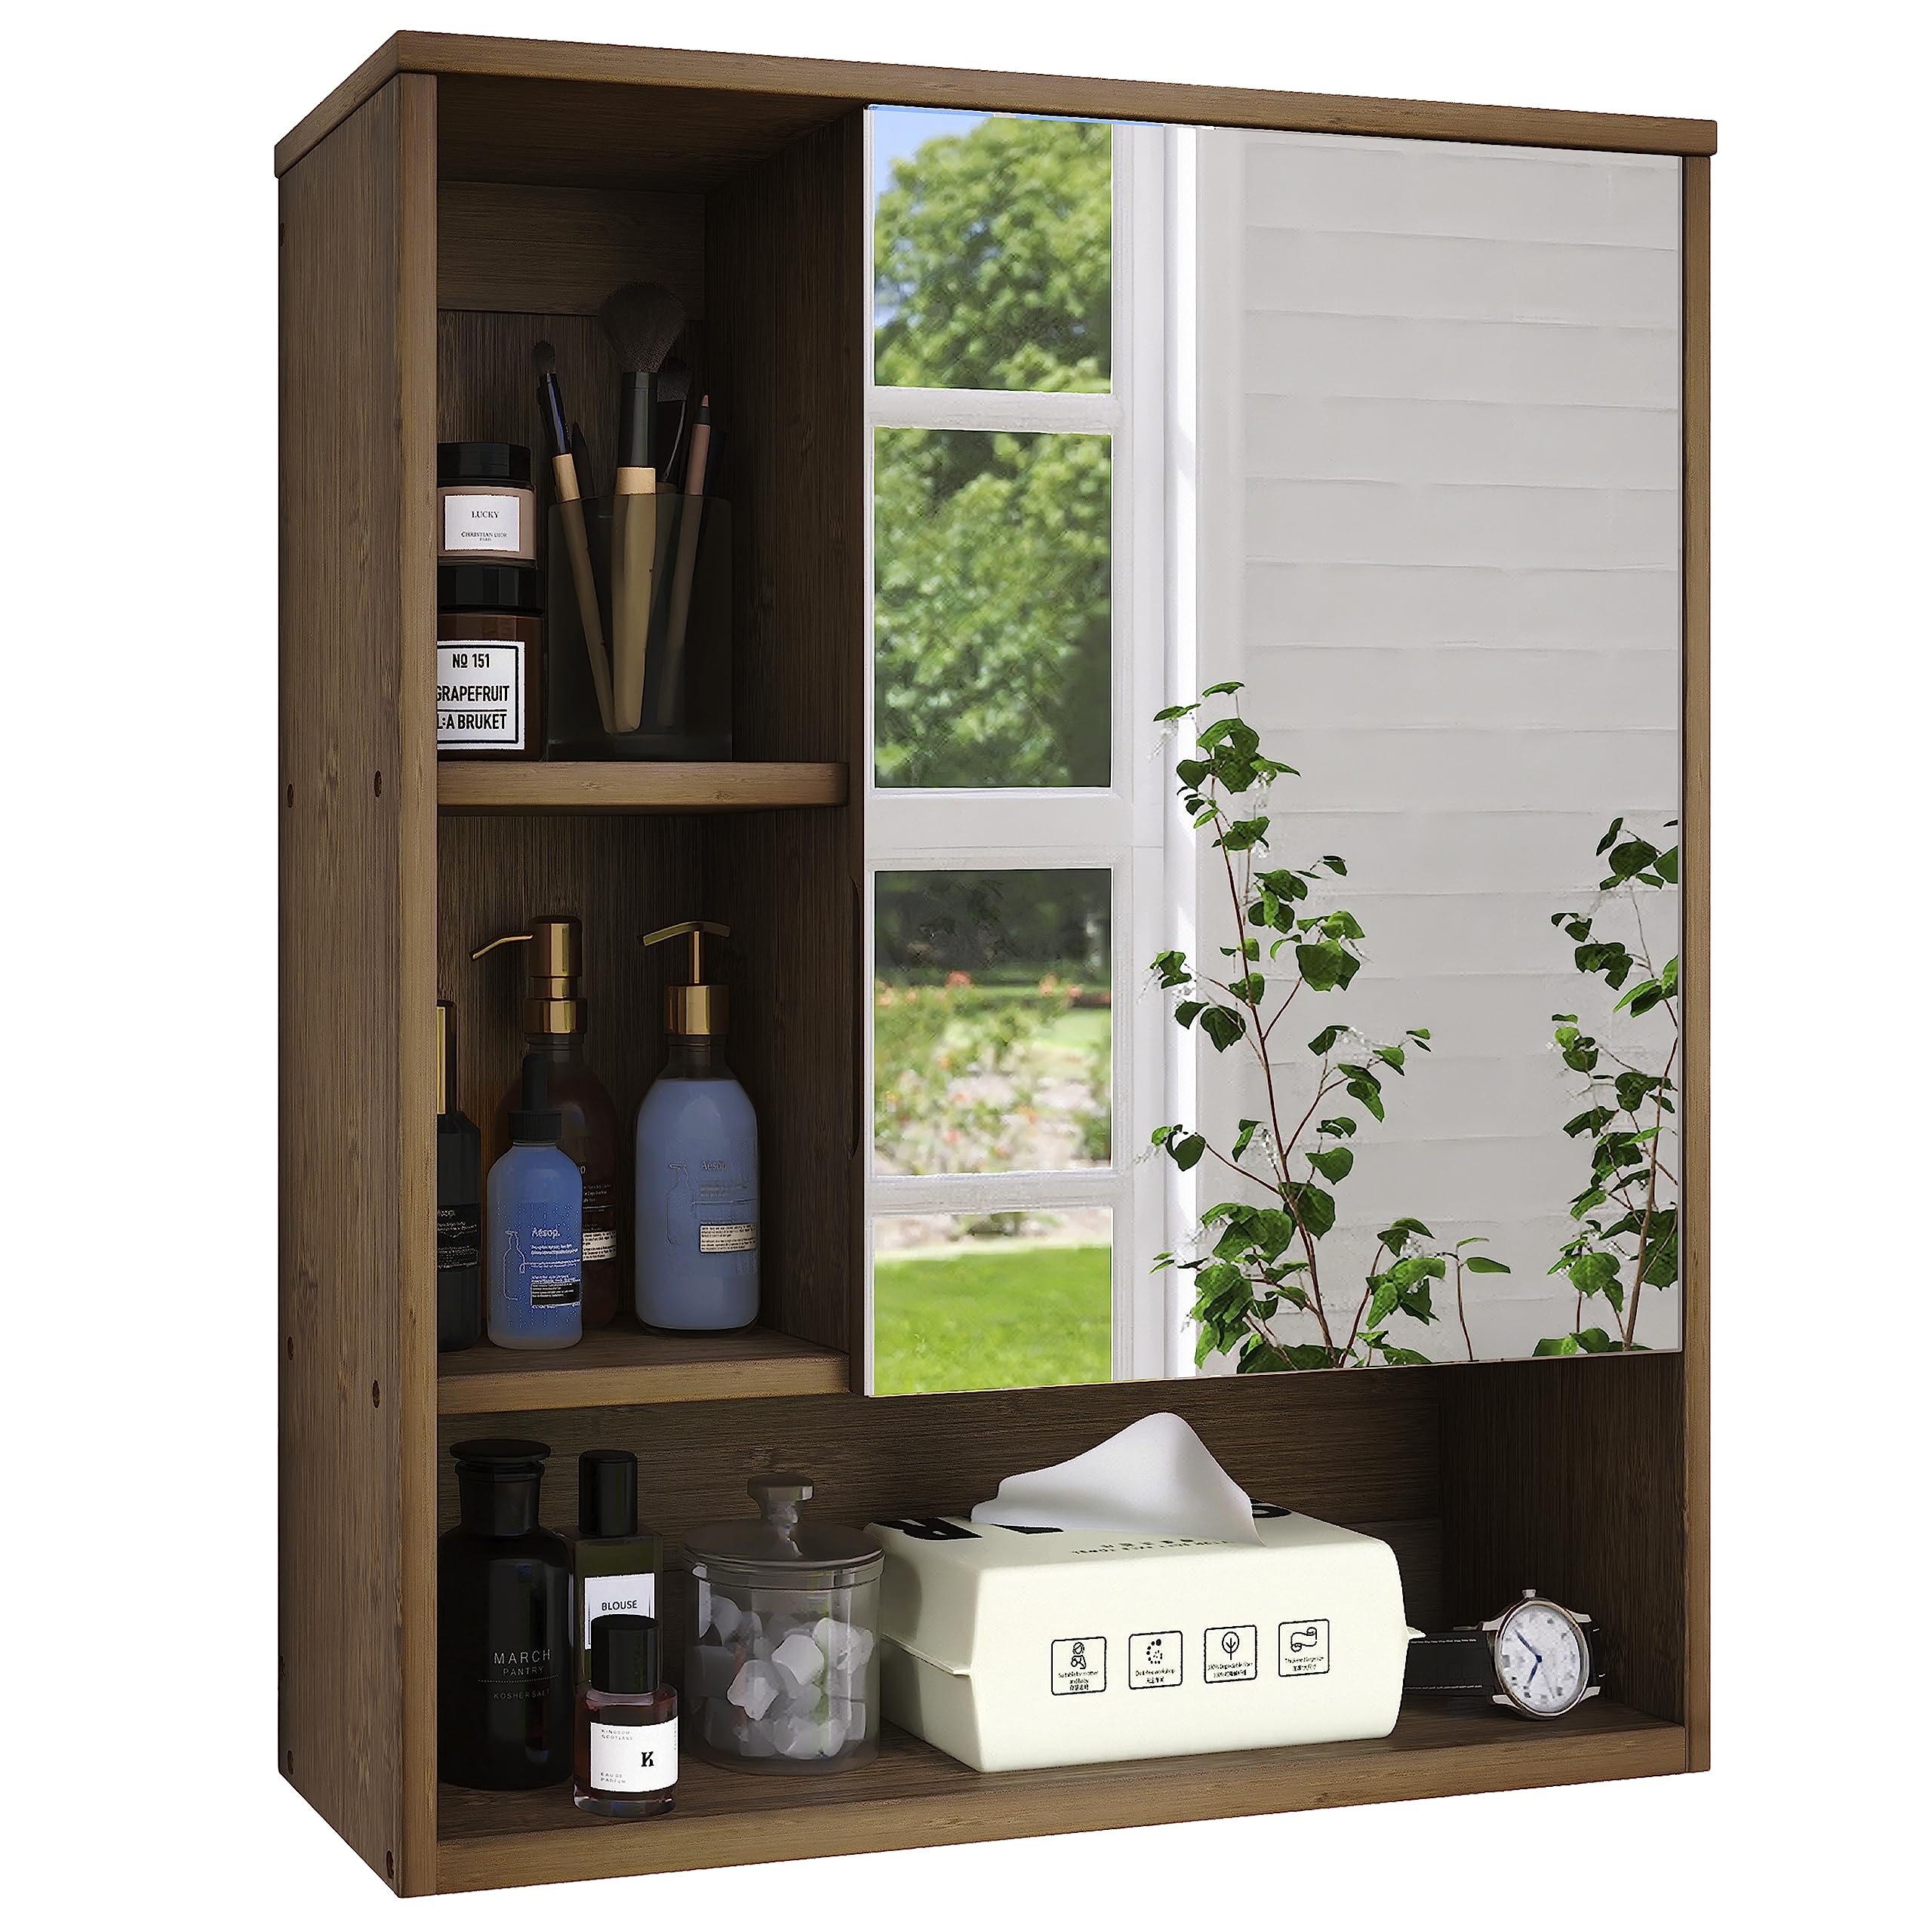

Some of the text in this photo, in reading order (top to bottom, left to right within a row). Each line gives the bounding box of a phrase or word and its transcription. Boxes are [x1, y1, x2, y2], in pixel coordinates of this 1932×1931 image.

[472, 653, 490, 669] 151
[457, 714, 507, 730] BRUKET
[601, 1600, 638, 1611] BLOUSE
[494, 1649, 550, 1665] MARCH
[503, 1665, 543, 1676] PANTRY
[531, 1688, 550, 1698] SALT
[641, 1751, 654, 1767] K
